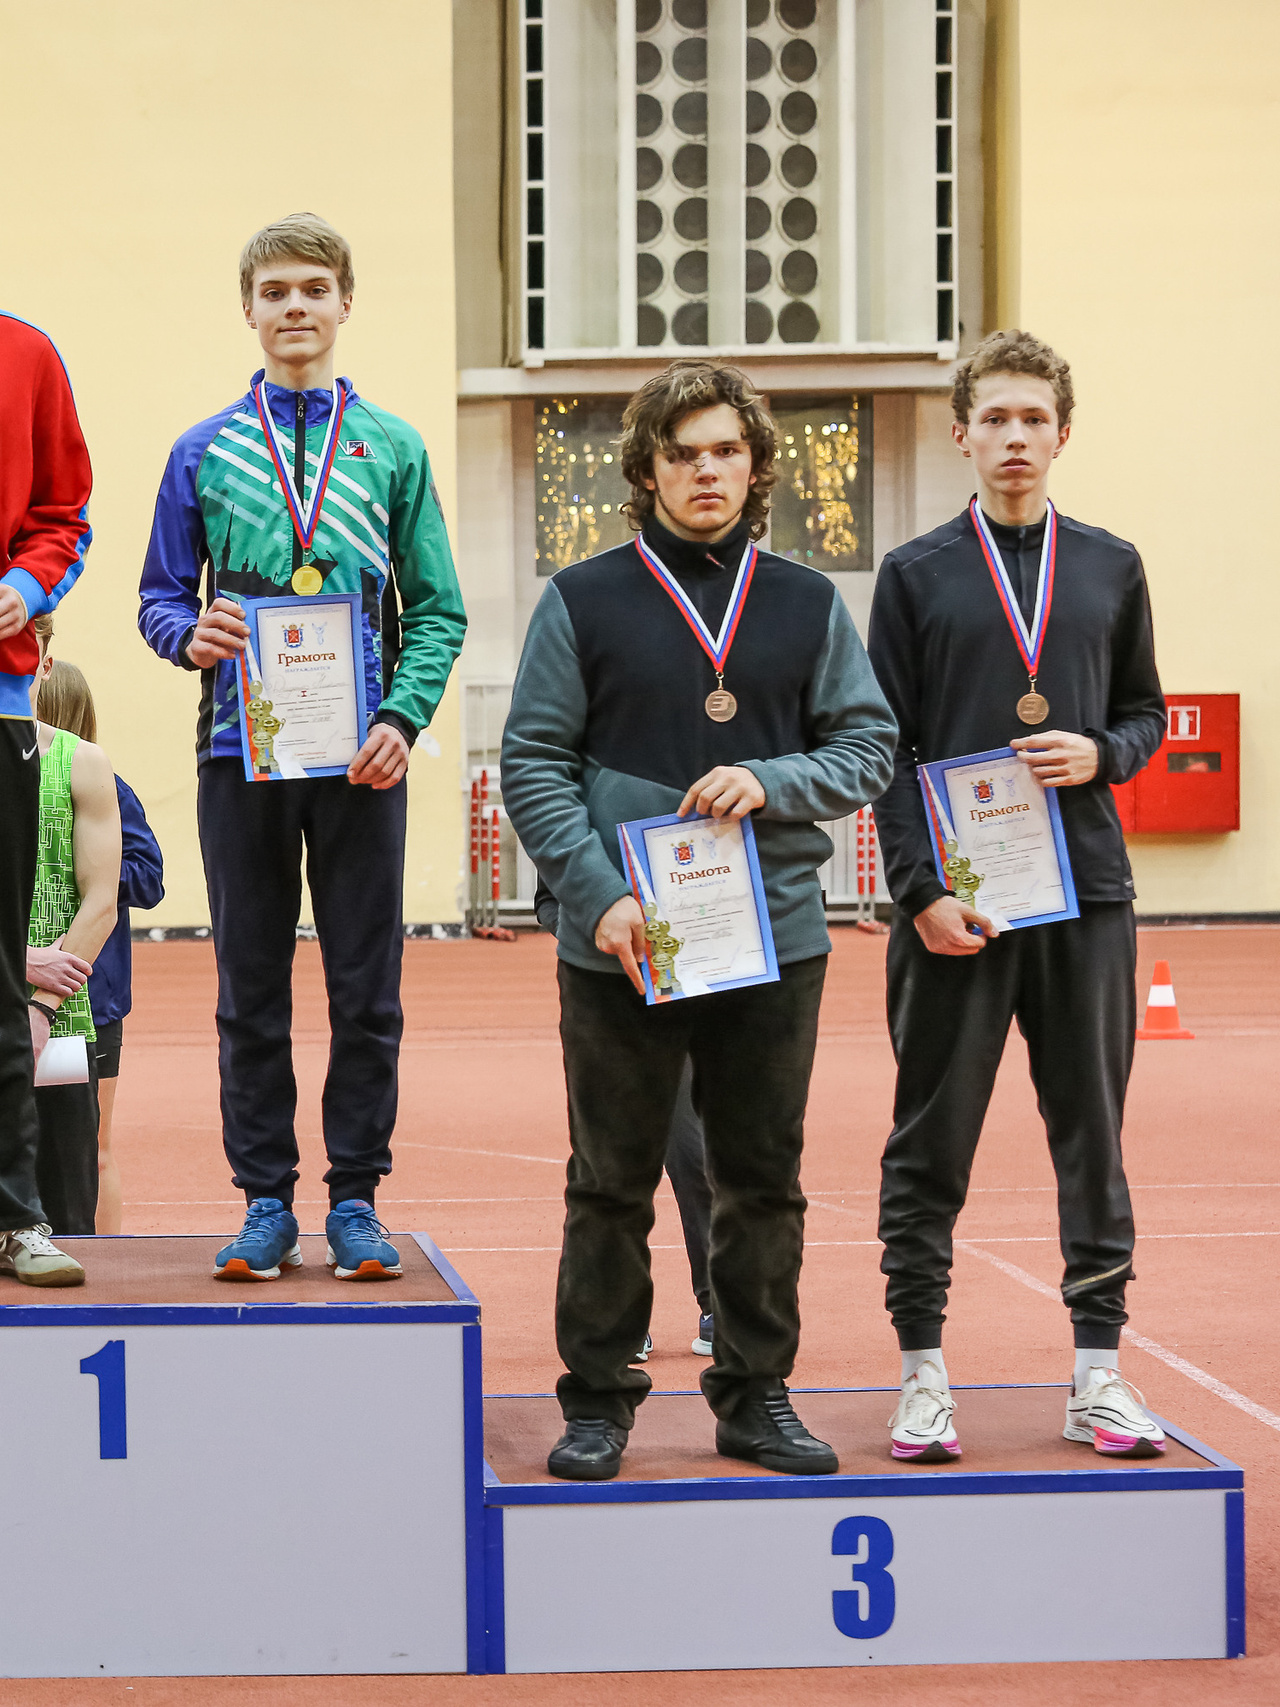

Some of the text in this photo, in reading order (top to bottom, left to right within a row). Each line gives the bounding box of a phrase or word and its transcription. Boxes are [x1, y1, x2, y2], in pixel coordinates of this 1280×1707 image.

[278, 652, 336, 667] Грамота
[970, 803, 1030, 822] Грамота
[669, 865, 731, 885] Грамота
[79, 1339, 128, 1460] 1
[831, 1516, 896, 1640] 3
